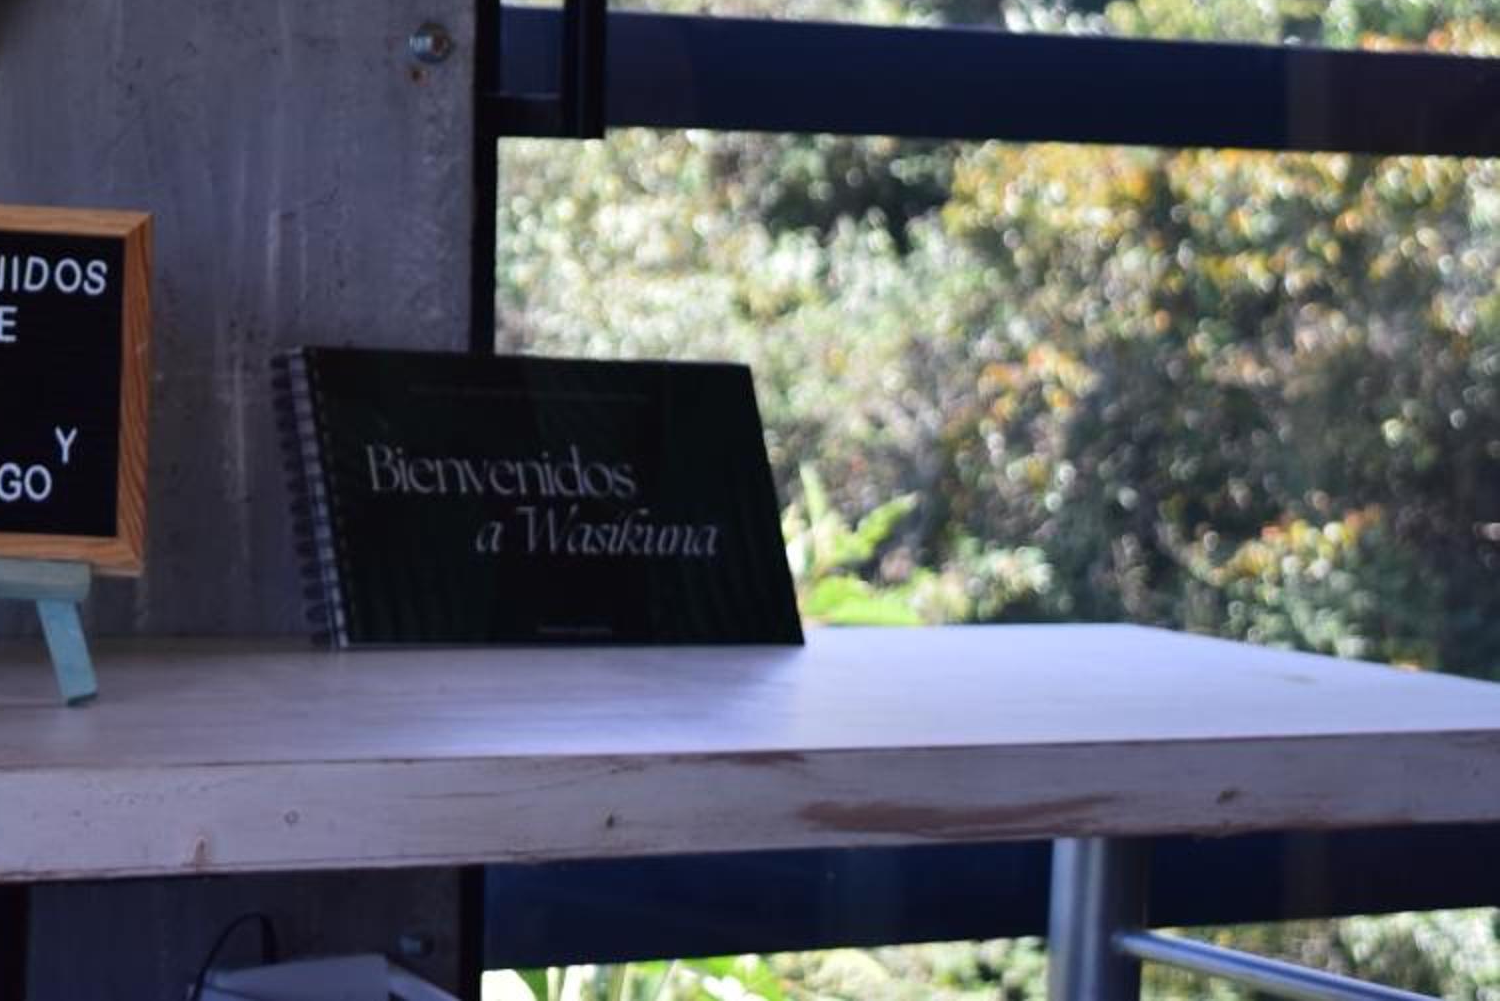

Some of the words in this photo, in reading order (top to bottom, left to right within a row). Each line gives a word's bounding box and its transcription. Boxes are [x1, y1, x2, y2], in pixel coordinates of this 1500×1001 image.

[55, 426, 78, 464] Y
[367, 445, 635, 497] Bienvenidos
[476, 522, 502, 552] a
